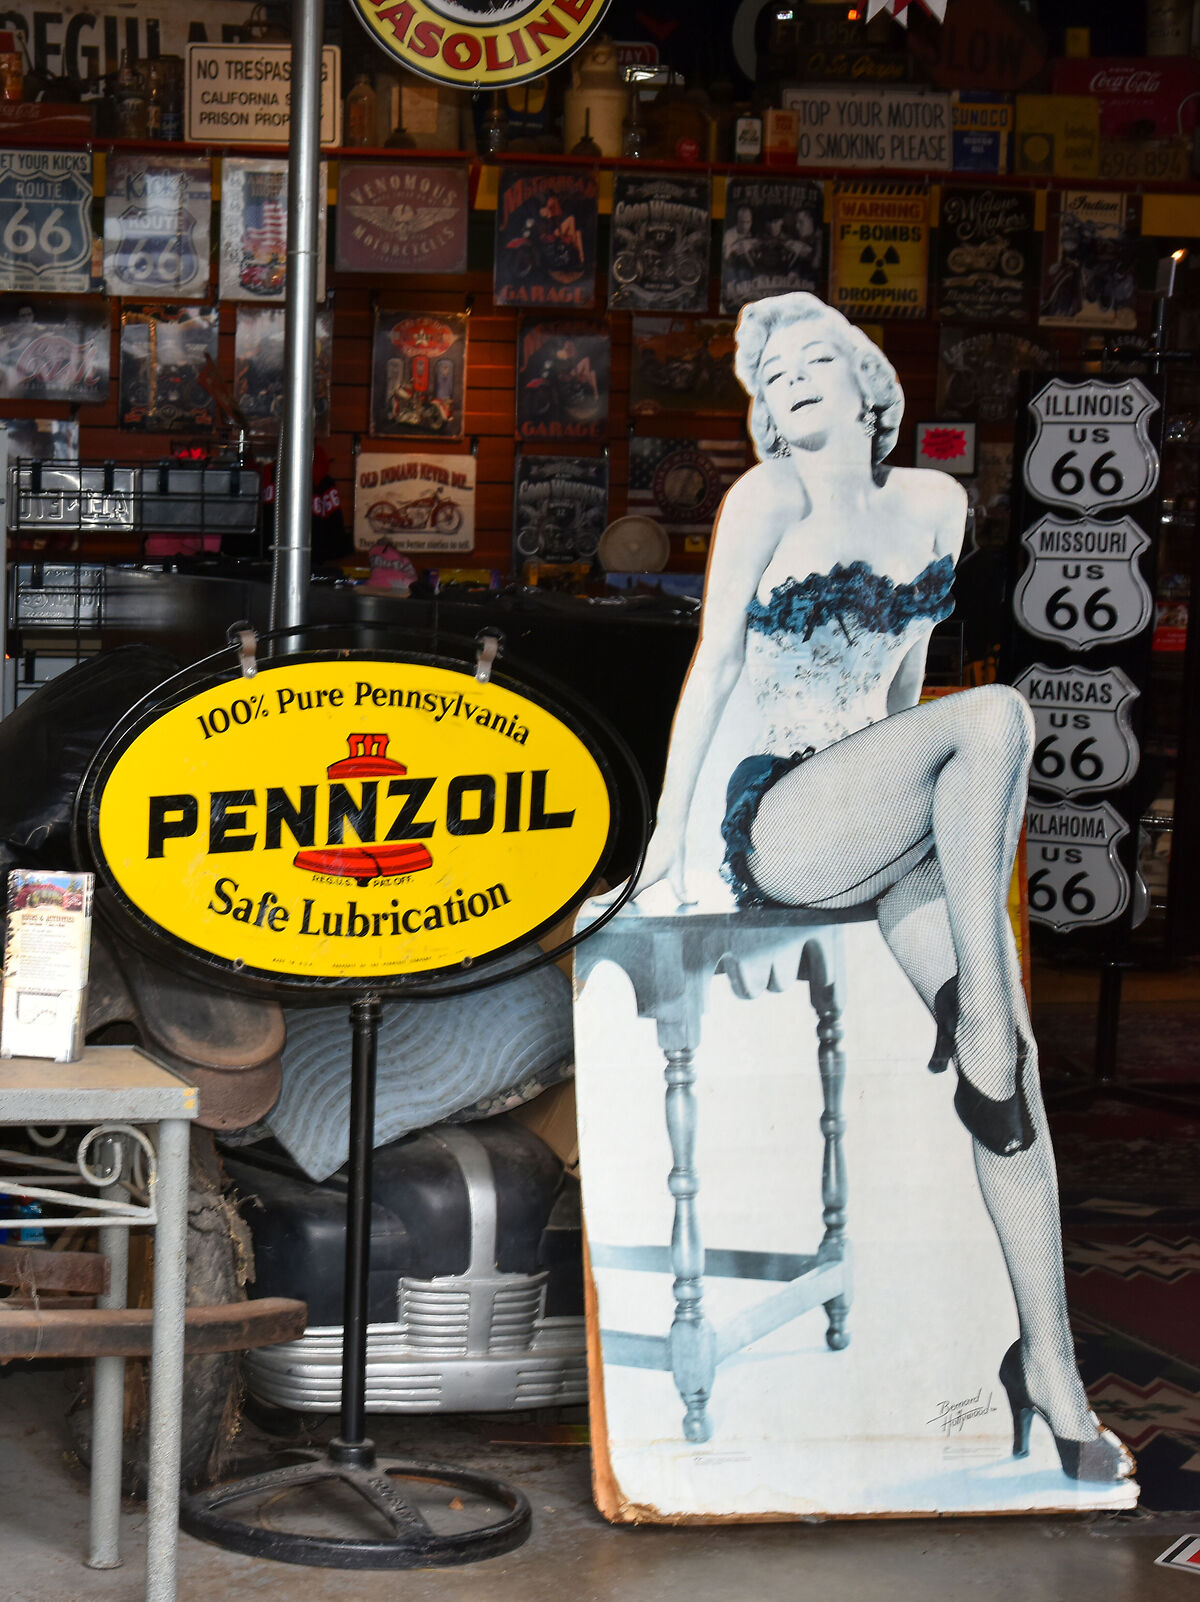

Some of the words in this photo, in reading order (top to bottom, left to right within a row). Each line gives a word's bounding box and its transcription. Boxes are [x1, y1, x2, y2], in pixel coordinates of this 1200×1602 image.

[351, 0, 594, 72] ASOLINE
[197, 60, 219, 80] NO
[1089, 71, 1161, 93] Coca-Cola
[201, 91, 278, 105] CALIFORNIA
[200, 112, 249, 125] PRISON
[838, 102, 881, 127] YOUR
[888, 103, 944, 128] MOTOR
[952, 106, 1009, 127] SUNOCO
[815, 135, 885, 159] SMOKING
[891, 137, 946, 161] PLEASE
[19, 154, 49, 170] YOUR
[52, 155, 87, 171] KICKS
[15, 182, 62, 198] ROUTE
[349, 173, 458, 208] VENOMOUS
[840, 201, 921, 219] WARNING
[1069, 196, 1119, 211] Indian
[3, 207, 72, 255] 66
[840, 224, 922, 242] F-BOMBS
[128, 236, 184, 280] 66
[838, 288, 919, 302] DROPPING
[1046, 395, 1133, 416] ILLINOIS
[522, 420, 600, 438] GARAGE
[1069, 428, 1110, 443] US
[360, 471, 378, 488] OLD
[380, 462, 418, 486] INDIANS
[420, 462, 450, 486] NEVER
[1052, 450, 1124, 496] 66
[1040, 532, 1127, 553] MISSOURI
[1063, 564, 1104, 580] US
[1046, 586, 1118, 631] 66
[1030, 679, 1113, 704] KANSAS
[197, 696, 268, 740] 100%
[277, 687, 343, 714] Pure
[356, 681, 531, 746] Pennsylvania
[1050, 712, 1090, 729] US
[1033, 734, 1104, 781] 66
[146, 769, 576, 859] PENNZOIL
[1042, 847, 1083, 863] US
[1028, 868, 1096, 915] 66
[207, 877, 290, 932] Safe
[299, 882, 512, 938] Lubrication
